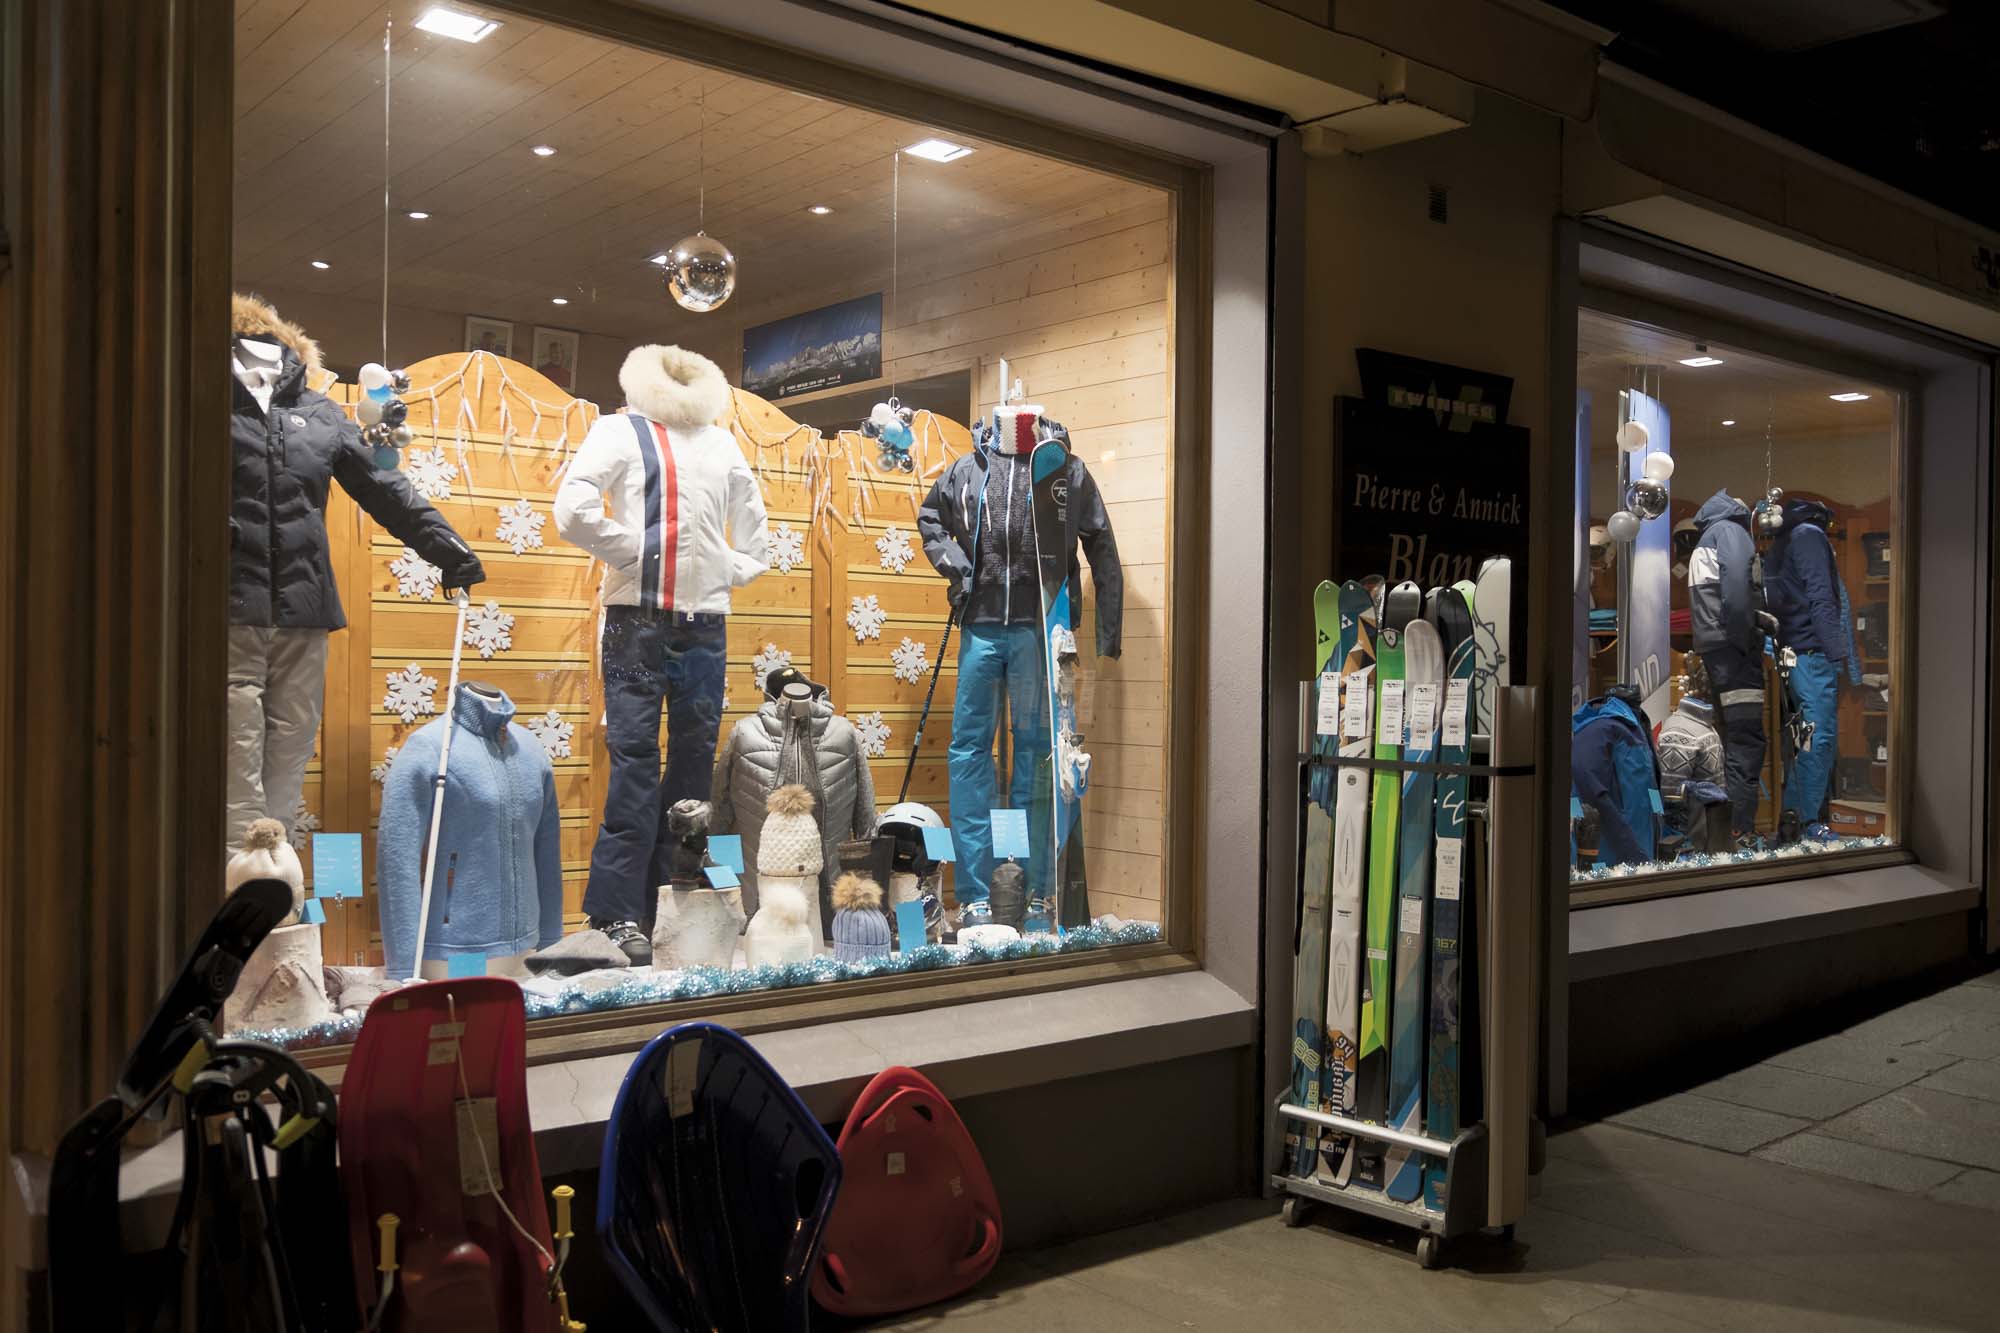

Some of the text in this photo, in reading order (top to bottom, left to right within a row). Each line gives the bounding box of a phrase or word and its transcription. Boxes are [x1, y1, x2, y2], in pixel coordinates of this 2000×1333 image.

[1352, 472, 1522, 525] Pierre & Annick
[1386, 532, 1477, 587] Blan
